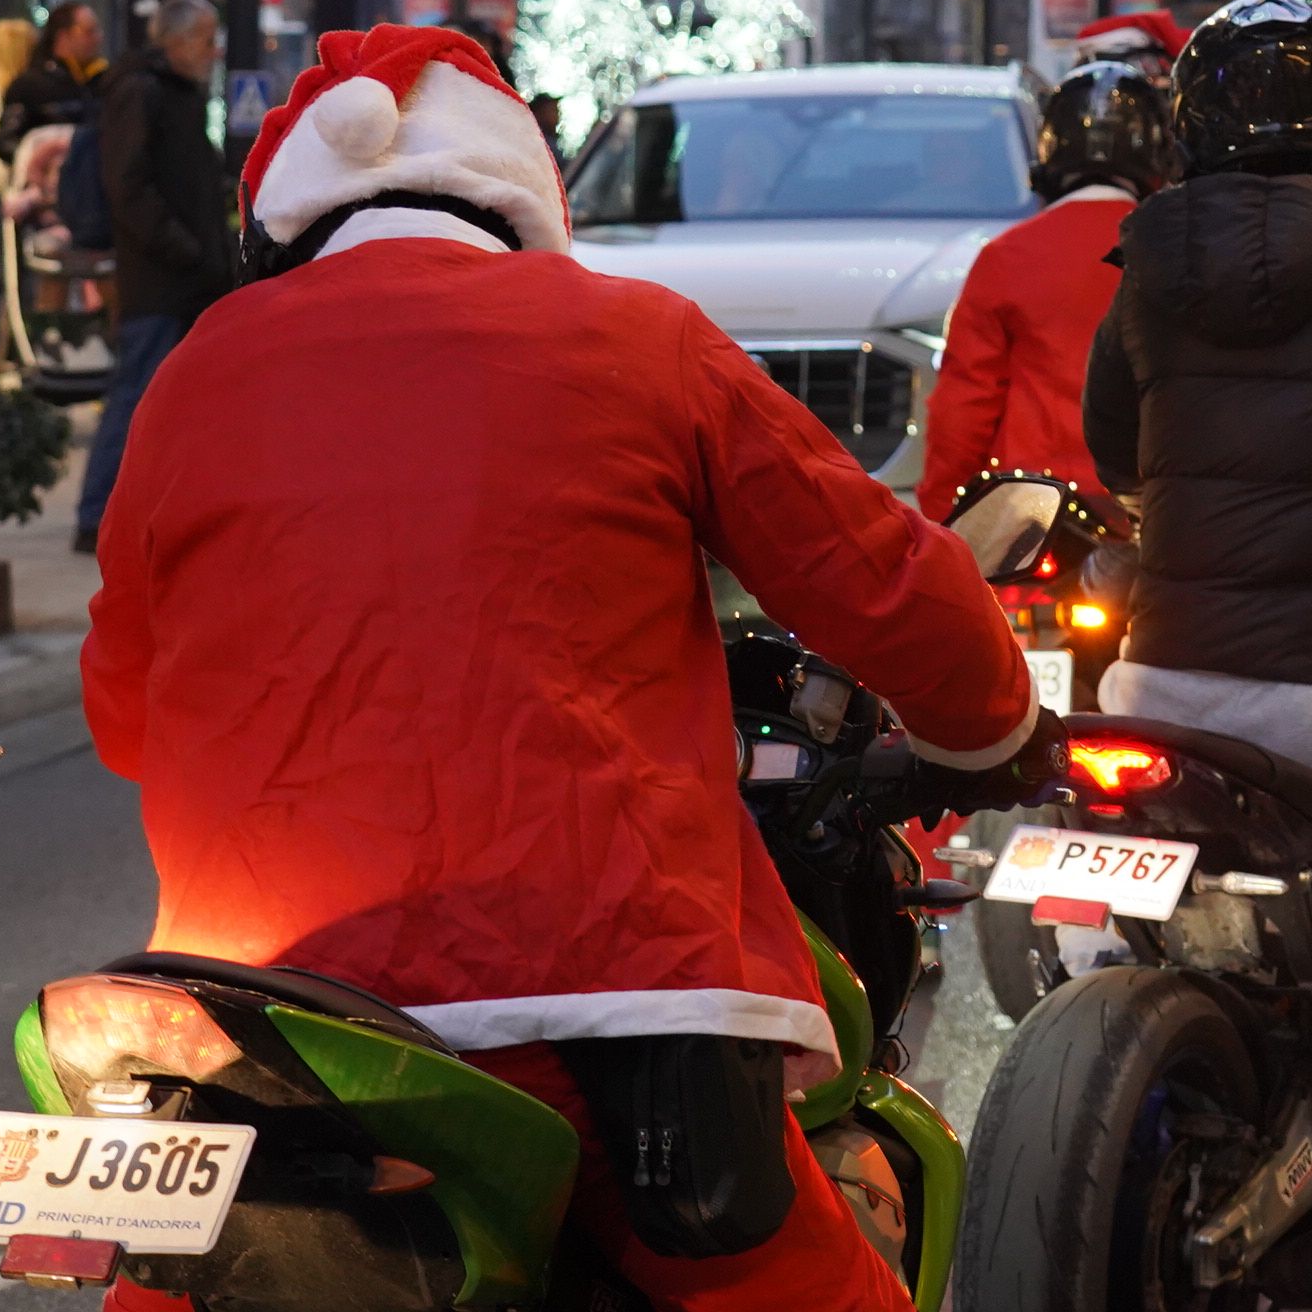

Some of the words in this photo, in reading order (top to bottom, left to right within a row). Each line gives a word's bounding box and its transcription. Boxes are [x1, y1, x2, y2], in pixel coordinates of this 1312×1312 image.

[1058, 842, 1179, 883] P5767
[45, 1137, 230, 1197] J3605
[36, 1211, 115, 1227] PRINCIPAT
[116, 1217, 202, 1230] D'ANDORRA
